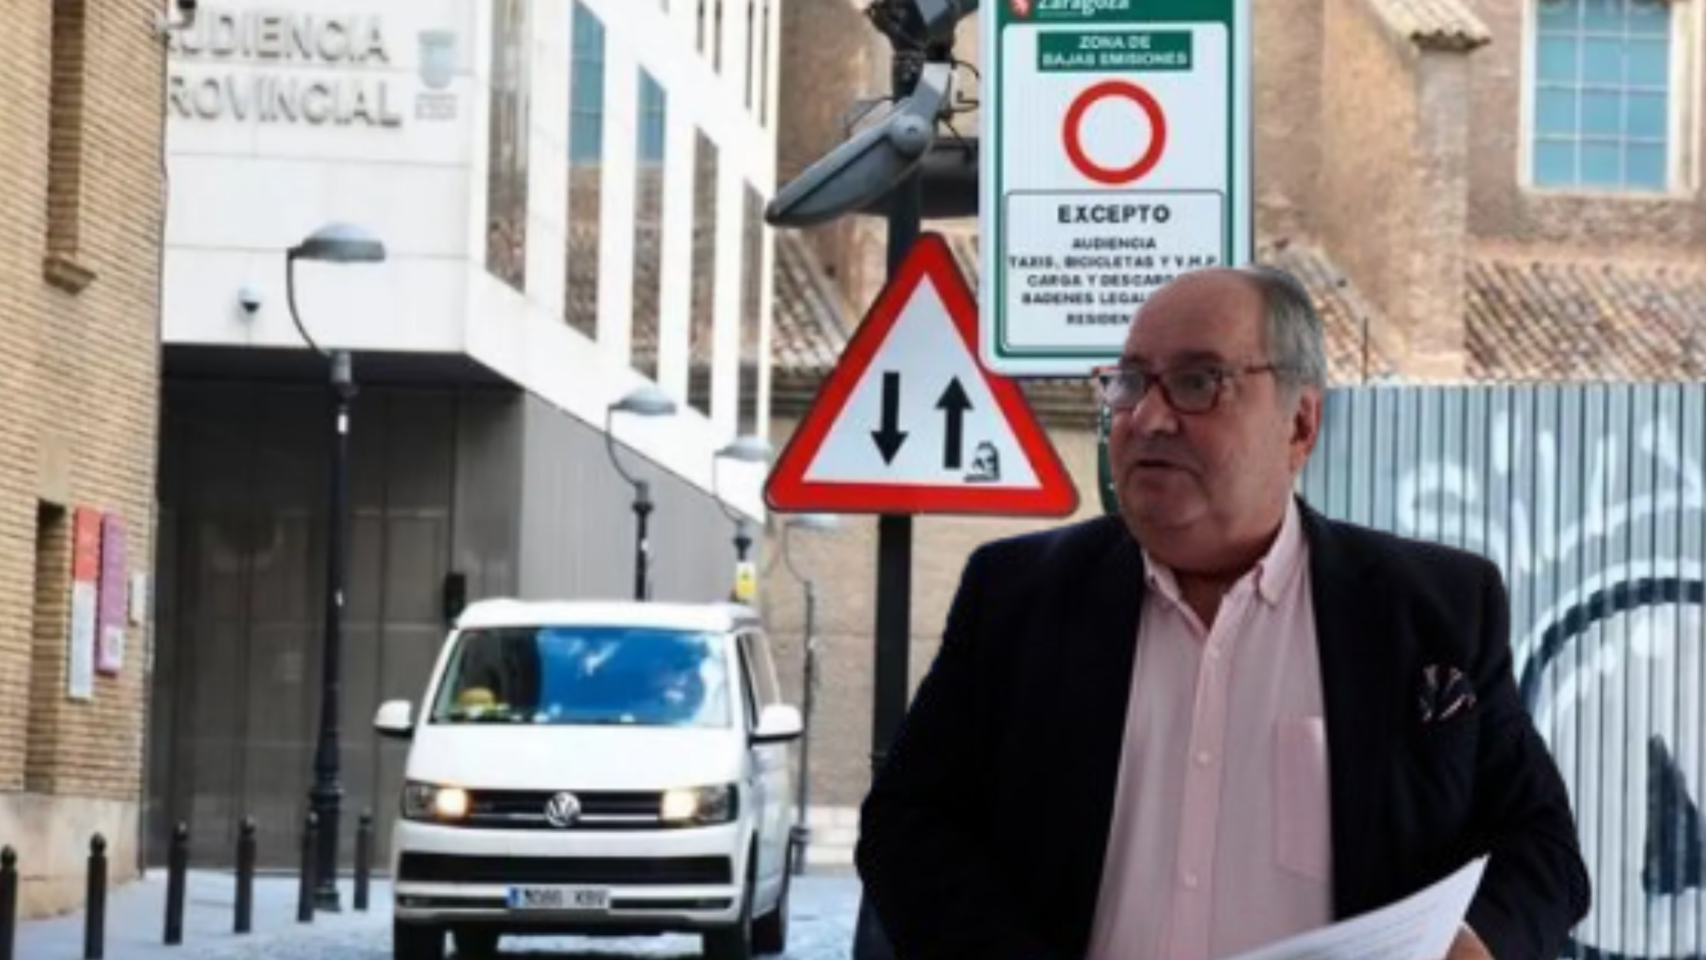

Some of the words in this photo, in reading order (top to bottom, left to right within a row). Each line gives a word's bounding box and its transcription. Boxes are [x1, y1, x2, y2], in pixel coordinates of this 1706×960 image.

[167, 8, 390, 62] UDIENCIA
[1079, 36, 1127, 49] ZONA
[1128, 36, 1151, 49] DE
[1042, 53, 1095, 65] BAJAS
[1101, 53, 1187, 65] EMISIONES
[169, 74, 402, 126] ROVINCIAL
[1057, 204, 1171, 223] EXCEPTO
[1072, 238, 1156, 249] AUDIENCIA
[1064, 256, 1153, 267] BICICLETAS
[1161, 256, 1170, 267] Y
[1026, 275, 1081, 287] CARGA
[1087, 275, 1096, 287] Y
[1021, 293, 1094, 305] BADENES
[1100, 293, 1147, 304] LEGAL
[1066, 314, 1131, 325] RESIDEN
